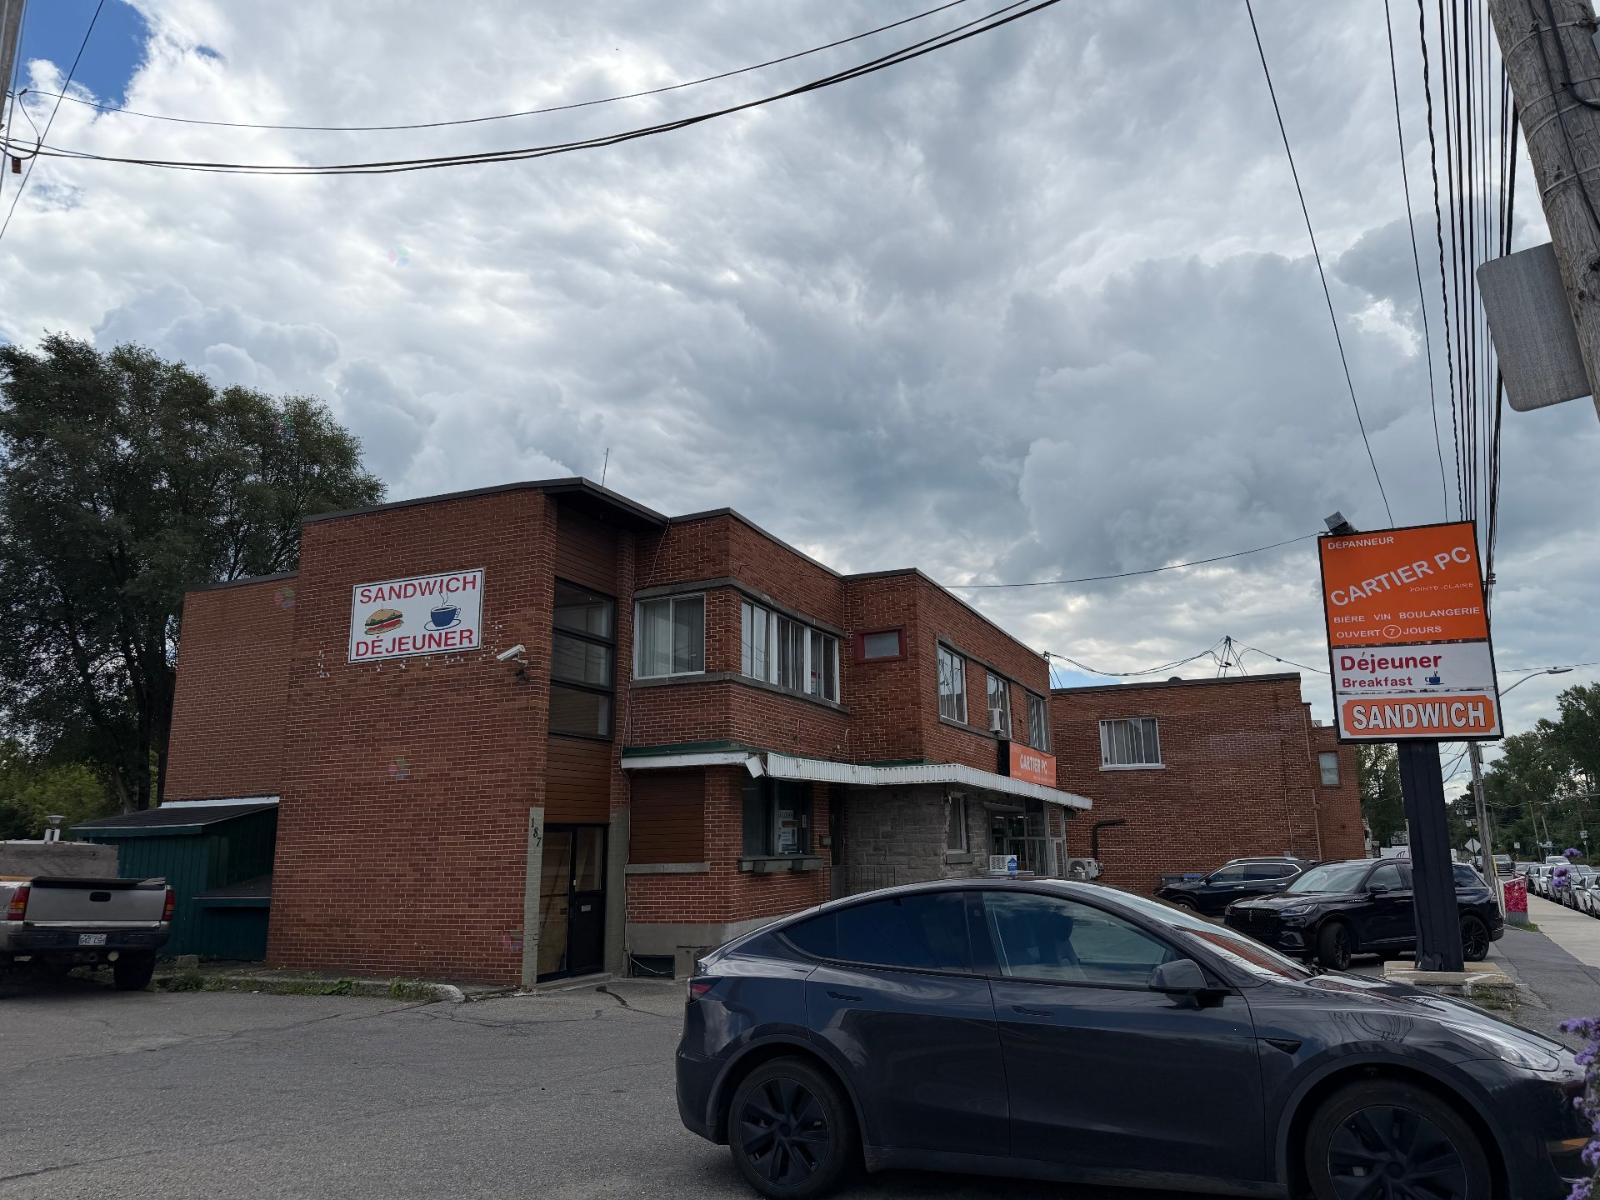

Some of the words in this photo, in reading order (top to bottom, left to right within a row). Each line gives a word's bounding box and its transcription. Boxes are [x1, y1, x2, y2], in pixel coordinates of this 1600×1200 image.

[359, 574, 477, 604] SANDWICH
[1330, 560, 1434, 606] CARTIER
[1434, 546, 1471, 570] PC
[1373, 613, 1391, 621] VIN
[1399, 607, 1480, 620] BOULANGERIE
[355, 628, 474, 657] DÉJEUNER
[1336, 629, 1381, 639] OUVERT
[1403, 626, 1442, 635] JOURS
[1340, 652, 1442, 674] Déjeuner
[1341, 675, 1413, 688] Breakfast
[1352, 702, 1486, 730] SANDWICH
[531, 817, 542, 848] 187
